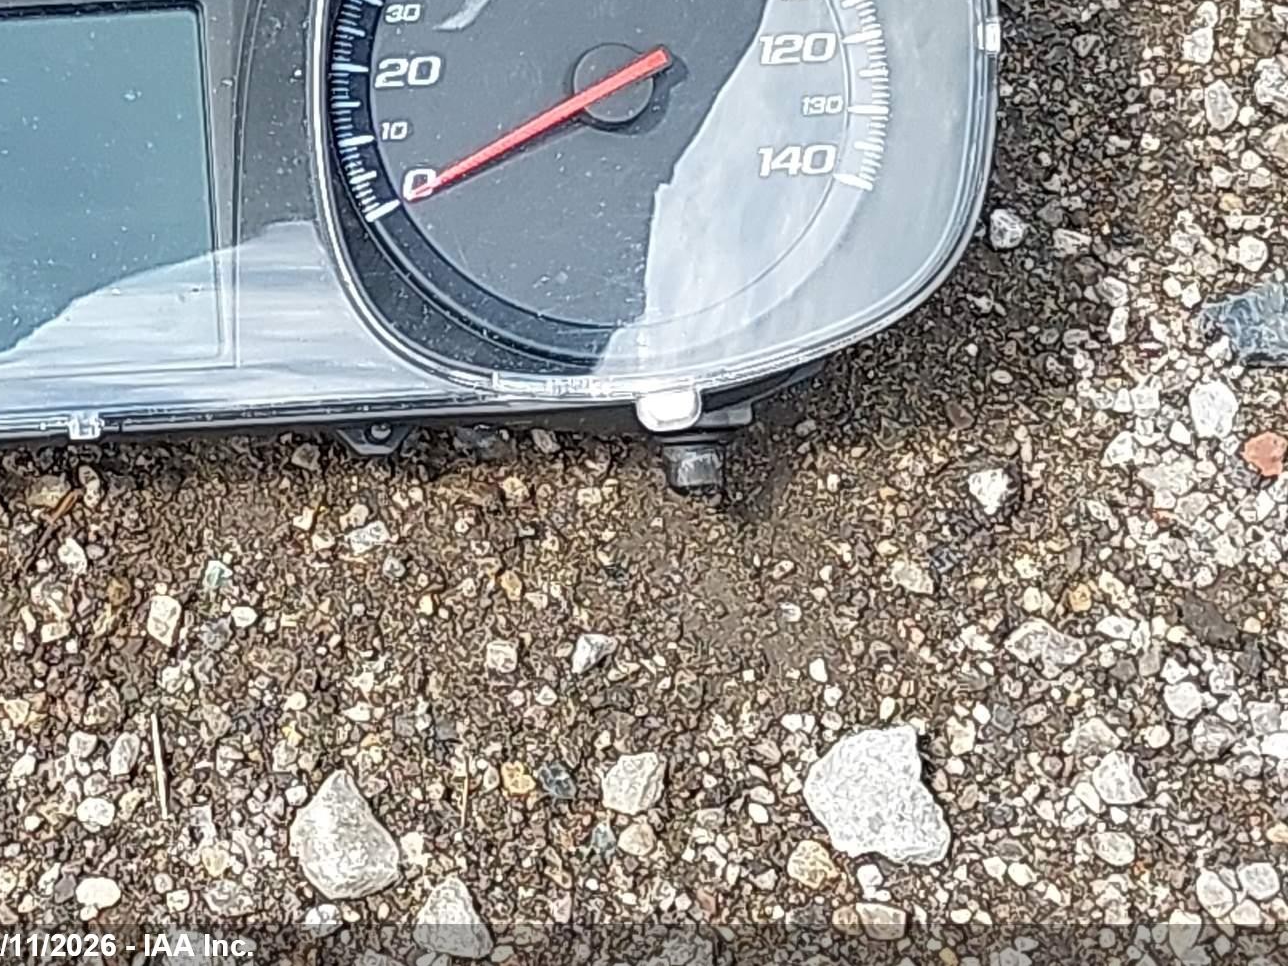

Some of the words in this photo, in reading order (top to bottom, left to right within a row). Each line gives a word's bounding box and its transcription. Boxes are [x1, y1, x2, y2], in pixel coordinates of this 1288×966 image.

[386, 5, 421, 22] 30
[759, 33, 837, 64] 120
[375, 57, 441, 88] 20
[802, 96, 843, 114] 130
[383, 121, 408, 139] 10
[758, 143, 837, 176] 140
[402, 169, 437, 200] 0
